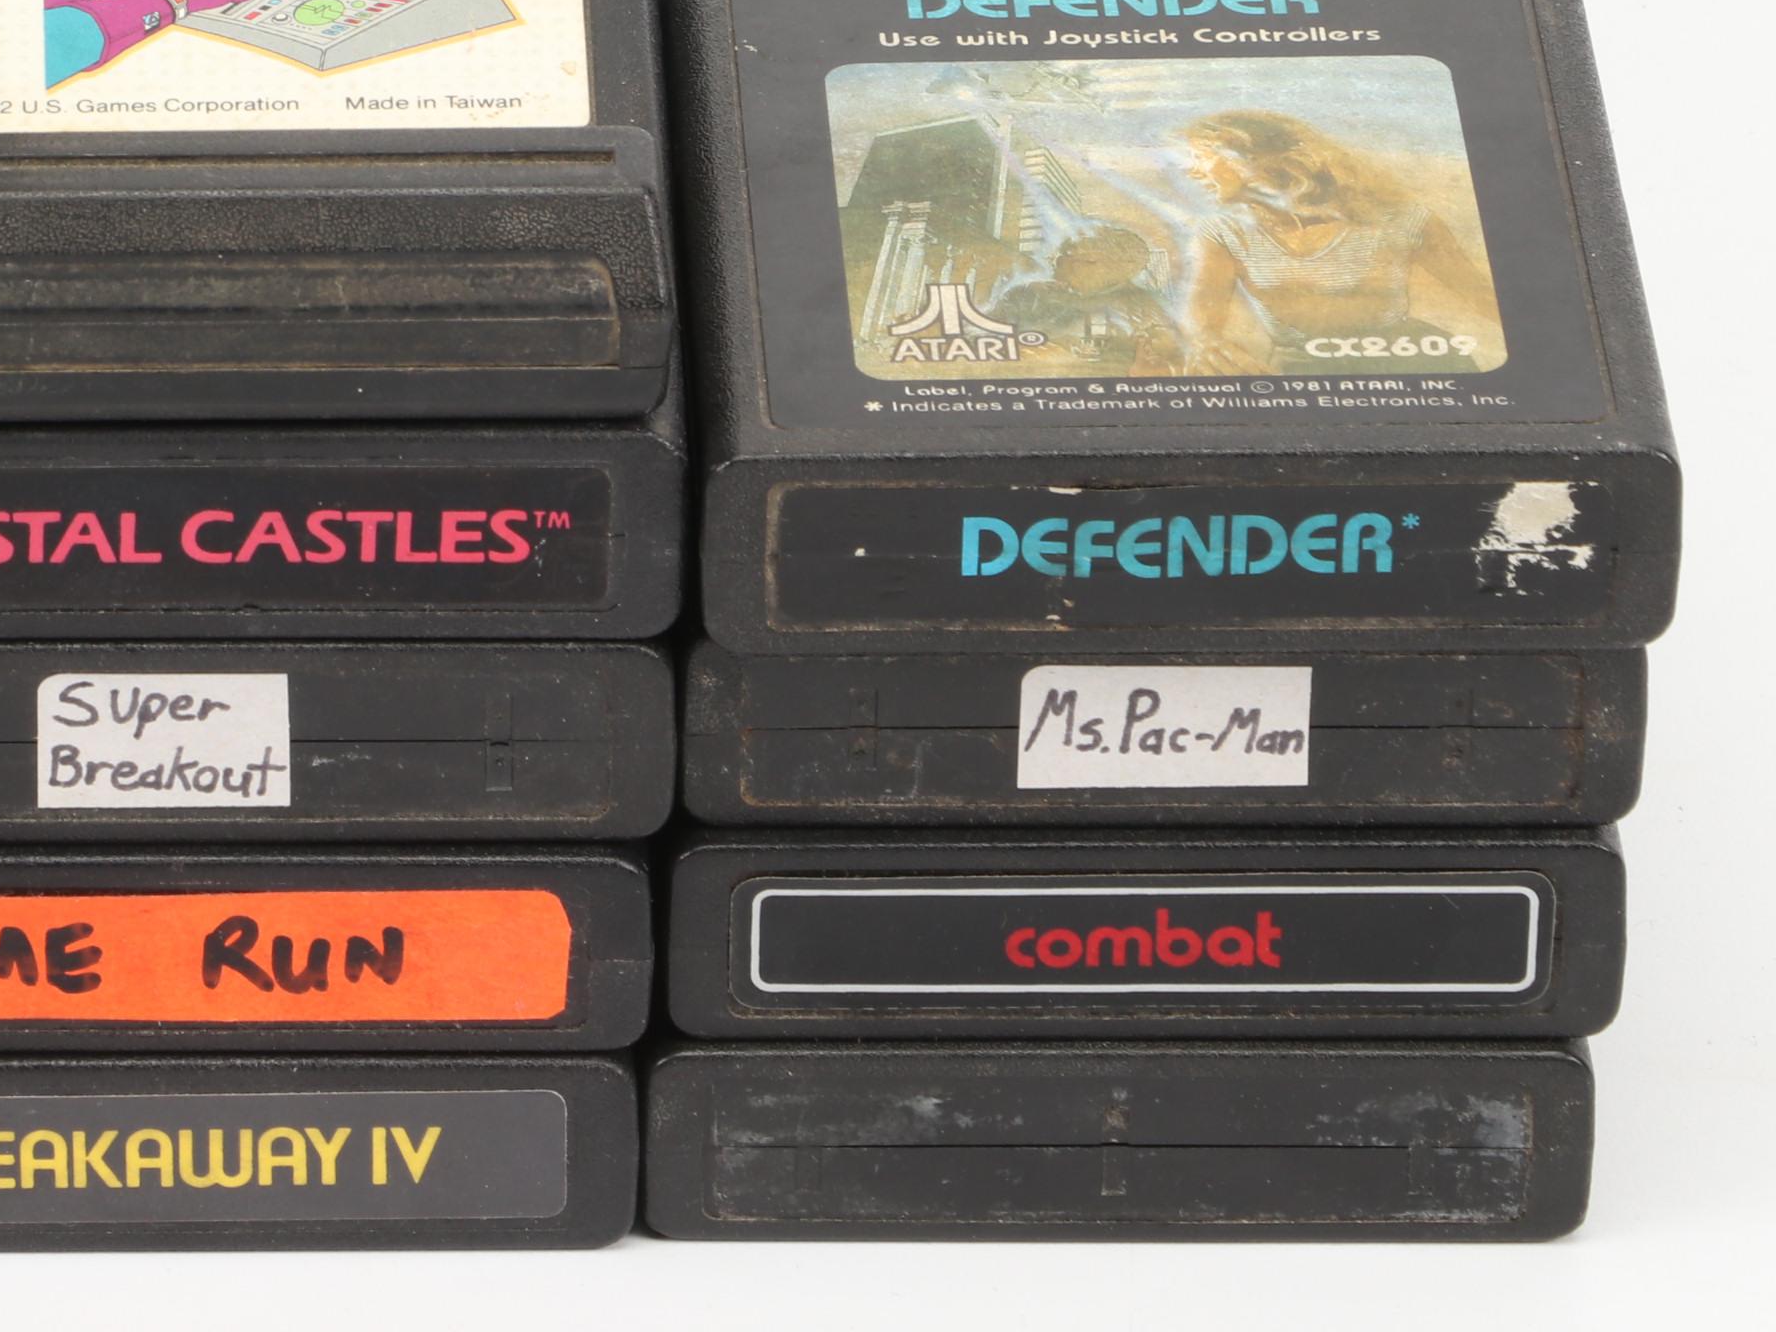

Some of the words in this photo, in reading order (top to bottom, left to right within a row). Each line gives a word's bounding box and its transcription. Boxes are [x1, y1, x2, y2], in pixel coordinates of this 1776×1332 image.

[878, 31, 942, 48] Use
[956, 29, 1029, 47] with
[1042, 28, 1179, 49] Joystick
[1193, 26, 1381, 43] Controllers
[21, 98, 67, 114] U.S.
[75, 98, 157, 113] Games
[164, 96, 300, 114] Corporation
[345, 95, 409, 110] Made
[417, 95, 436, 110] in
[444, 94, 523, 109] Taiwan
[1304, 334, 1478, 358] CX2609
[982, 383, 1079, 398] Program
[1087, 382, 1105, 395] &
[1114, 380, 1242, 395] Audiovisual
[1281, 380, 1331, 393] 1981
[1339, 379, 1412, 392] ATARI,
[1421, 379, 1464, 392] INC.
[891, 397, 1003, 412] Indicates
[1012, 400, 1026, 411] a
[1034, 397, 1160, 411] Trademark
[1169, 397, 1193, 410] of
[1201, 395, 1309, 409] Williams
[1317, 395, 1464, 409] Electronics,
[1472, 394, 1517, 407] Inc.
[51, 680, 232, 738] Super
[48, 744, 288, 797] Breakout
[1002, 907, 1285, 970] combat
[200, 918, 406, 994] RUN
[371, 1125, 443, 1186] IV
